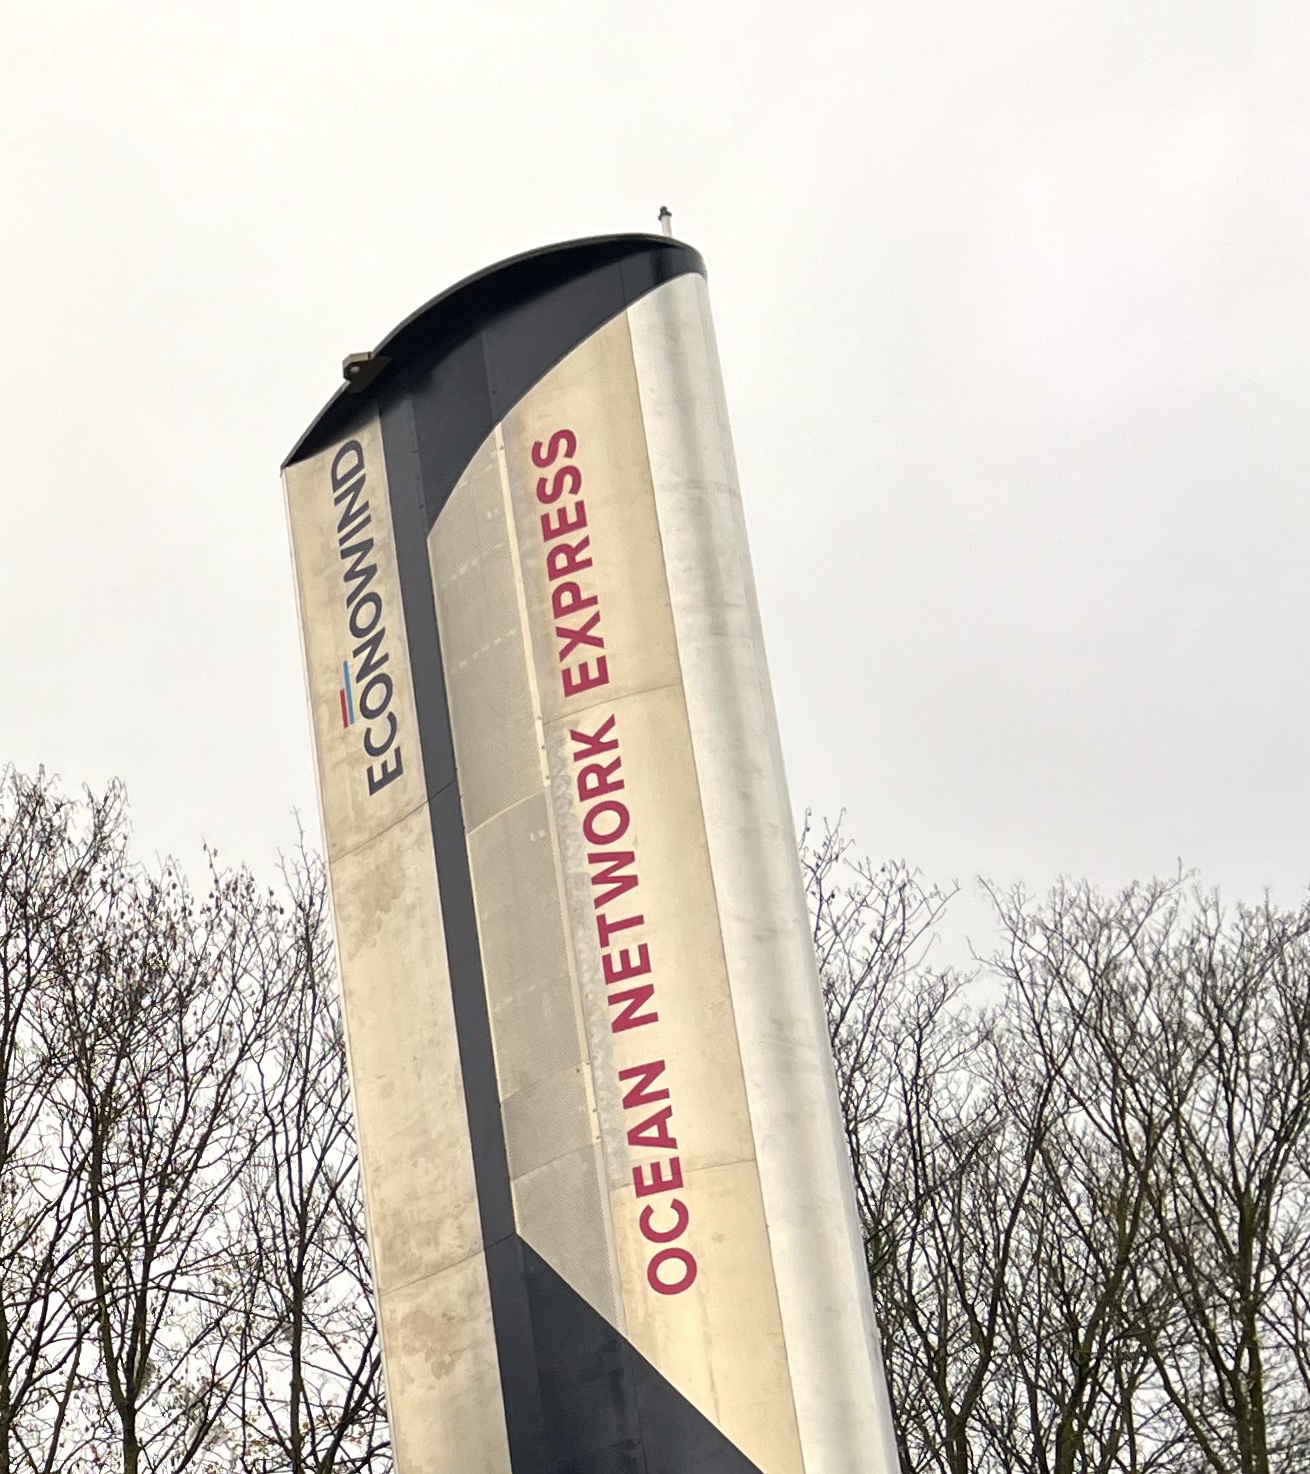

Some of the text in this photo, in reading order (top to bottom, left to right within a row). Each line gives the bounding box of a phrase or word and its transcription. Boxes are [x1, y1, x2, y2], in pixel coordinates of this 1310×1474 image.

[331, 440, 404, 796] ECONOWIND
[531, 428, 698, 1296] OCEAN NETWORK EXPRESS
